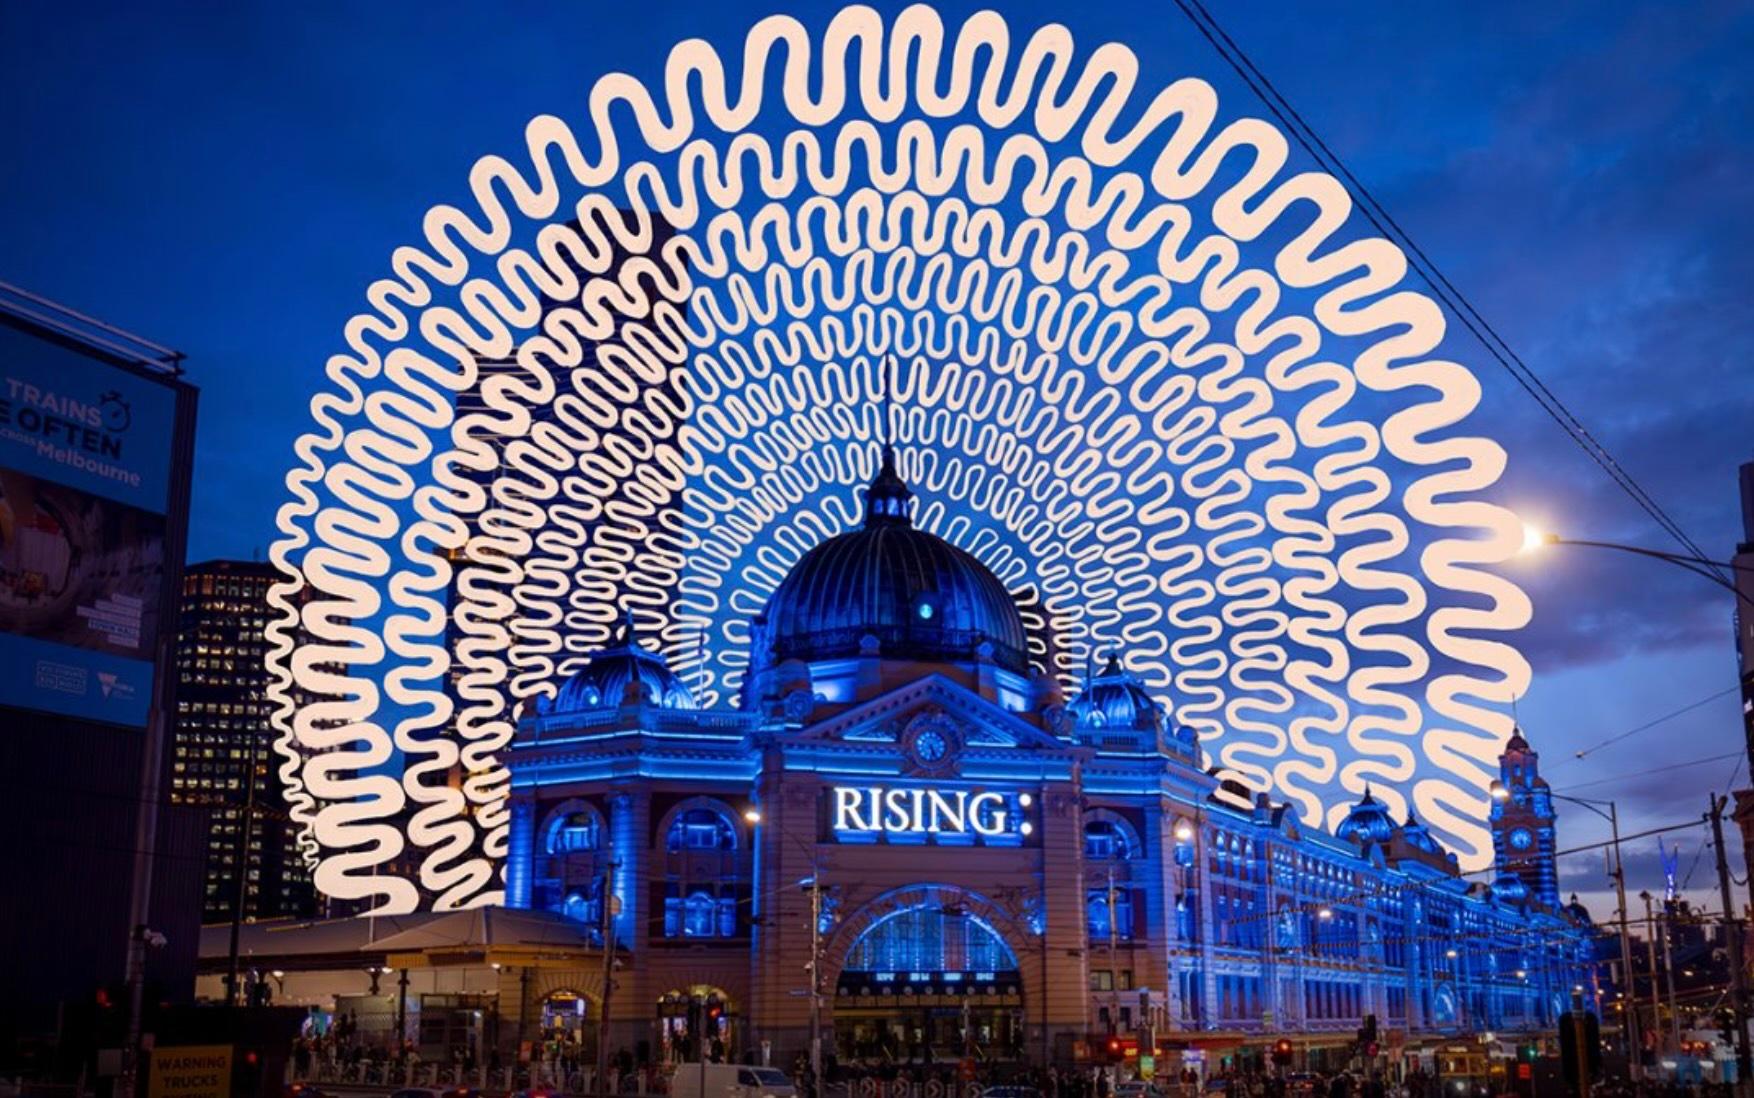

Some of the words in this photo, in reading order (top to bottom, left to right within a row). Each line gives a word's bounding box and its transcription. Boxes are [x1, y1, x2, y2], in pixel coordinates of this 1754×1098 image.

[6, 377, 102, 428] TRAINS
[17, 407, 122, 460] OFTEN
[36, 440, 141, 487] Melbourne
[158, 1056, 226, 1071] WARNING
[163, 1074, 218, 1089] TRUCKS
